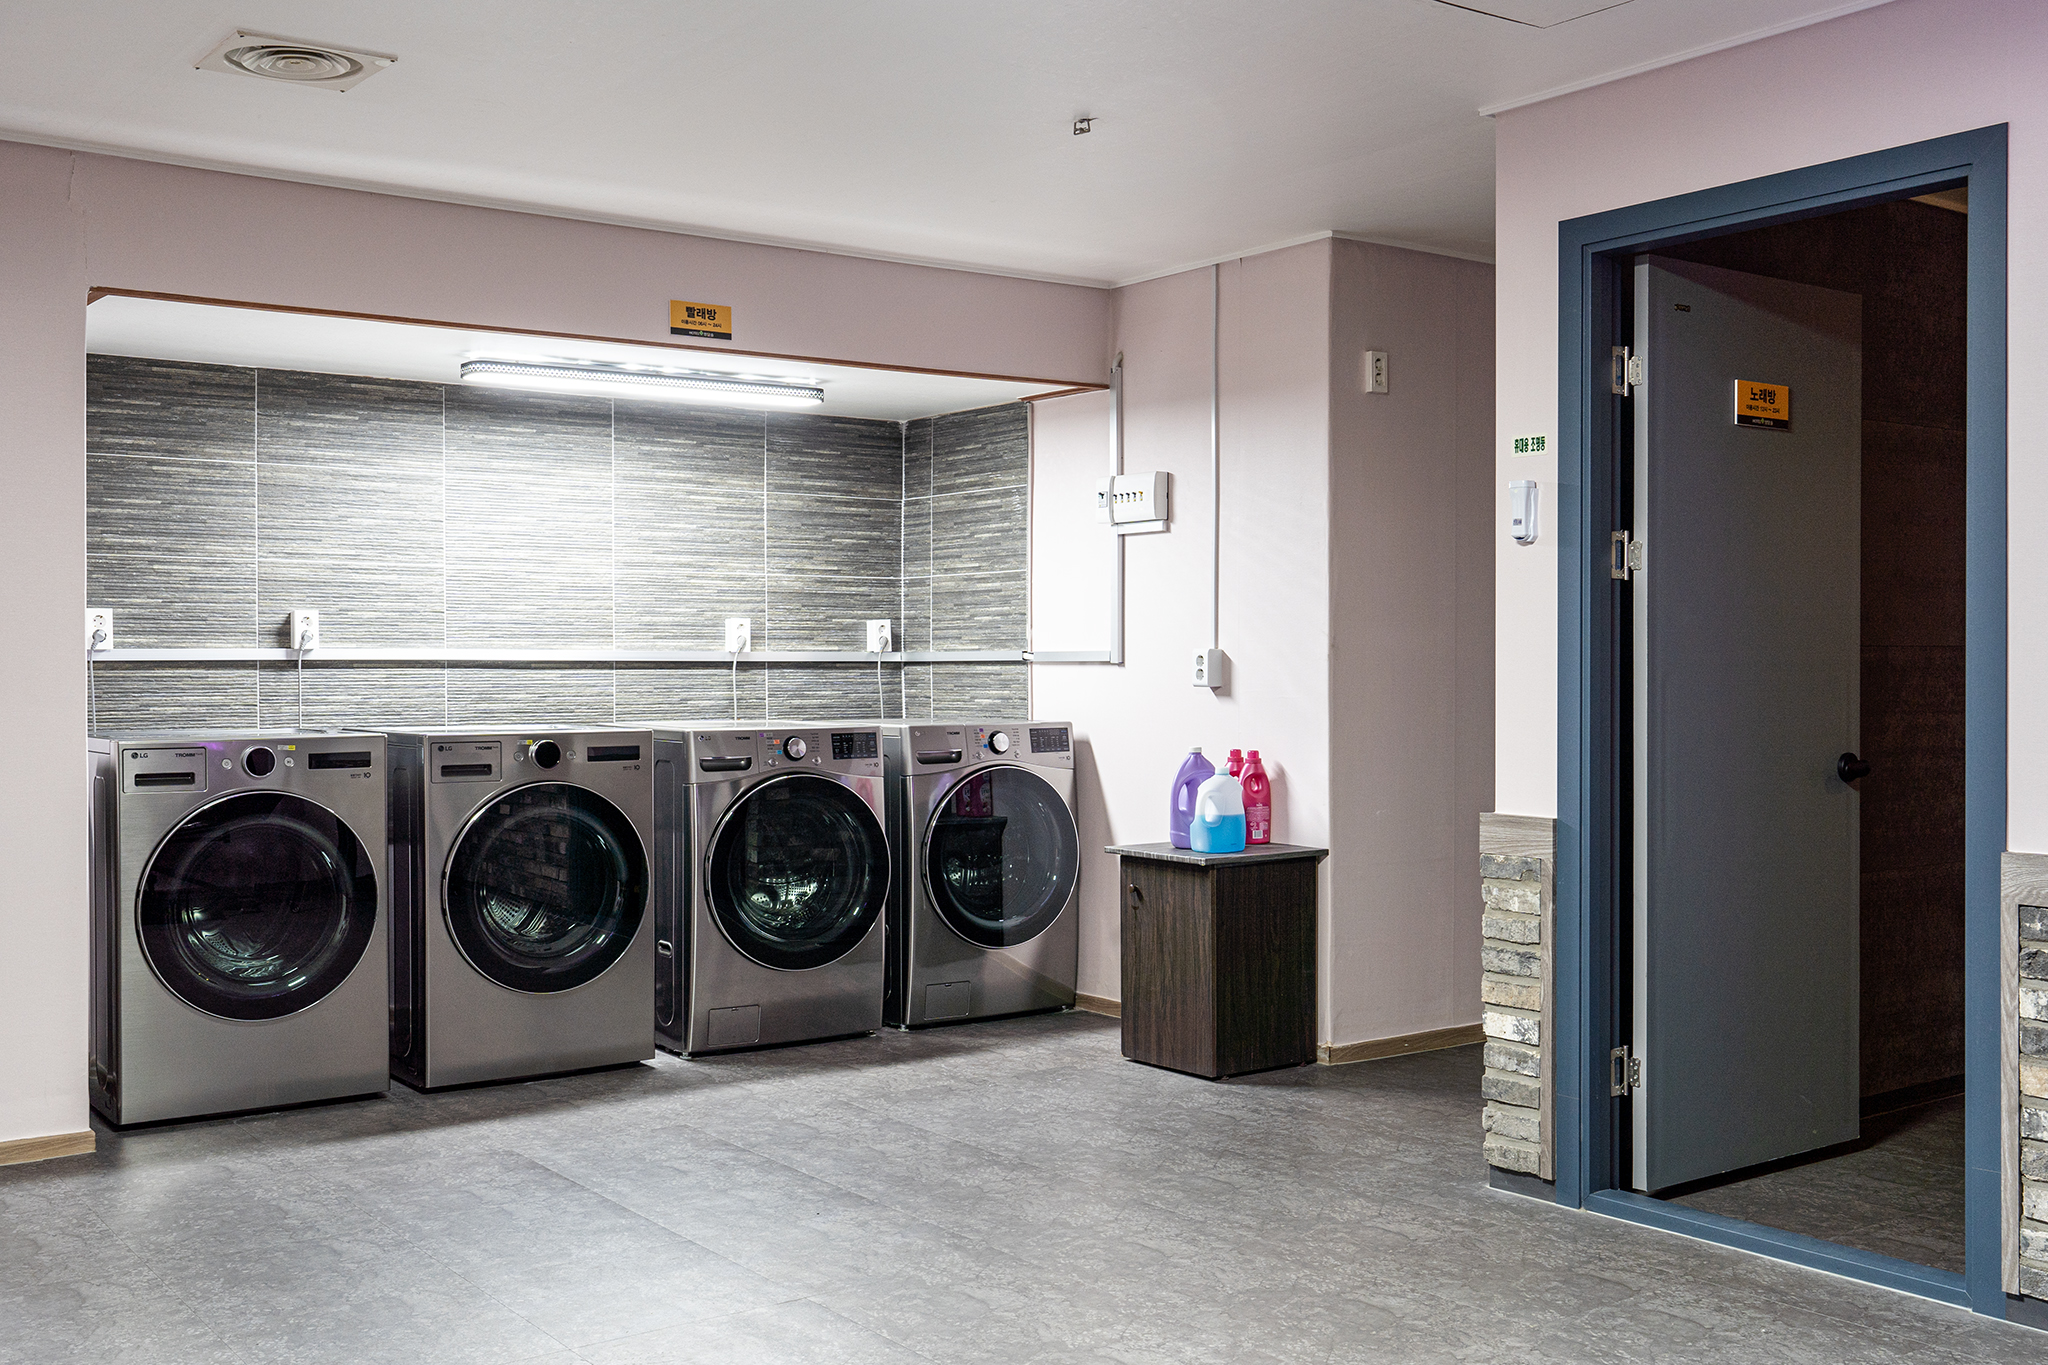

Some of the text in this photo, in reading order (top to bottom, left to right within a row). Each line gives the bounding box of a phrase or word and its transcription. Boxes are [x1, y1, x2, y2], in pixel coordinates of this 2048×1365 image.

[685, 306, 717, 321] 빨래방
[1750, 387, 1776, 405] 노래방
[1514, 435, 1545, 454] 휴대용 조명등
